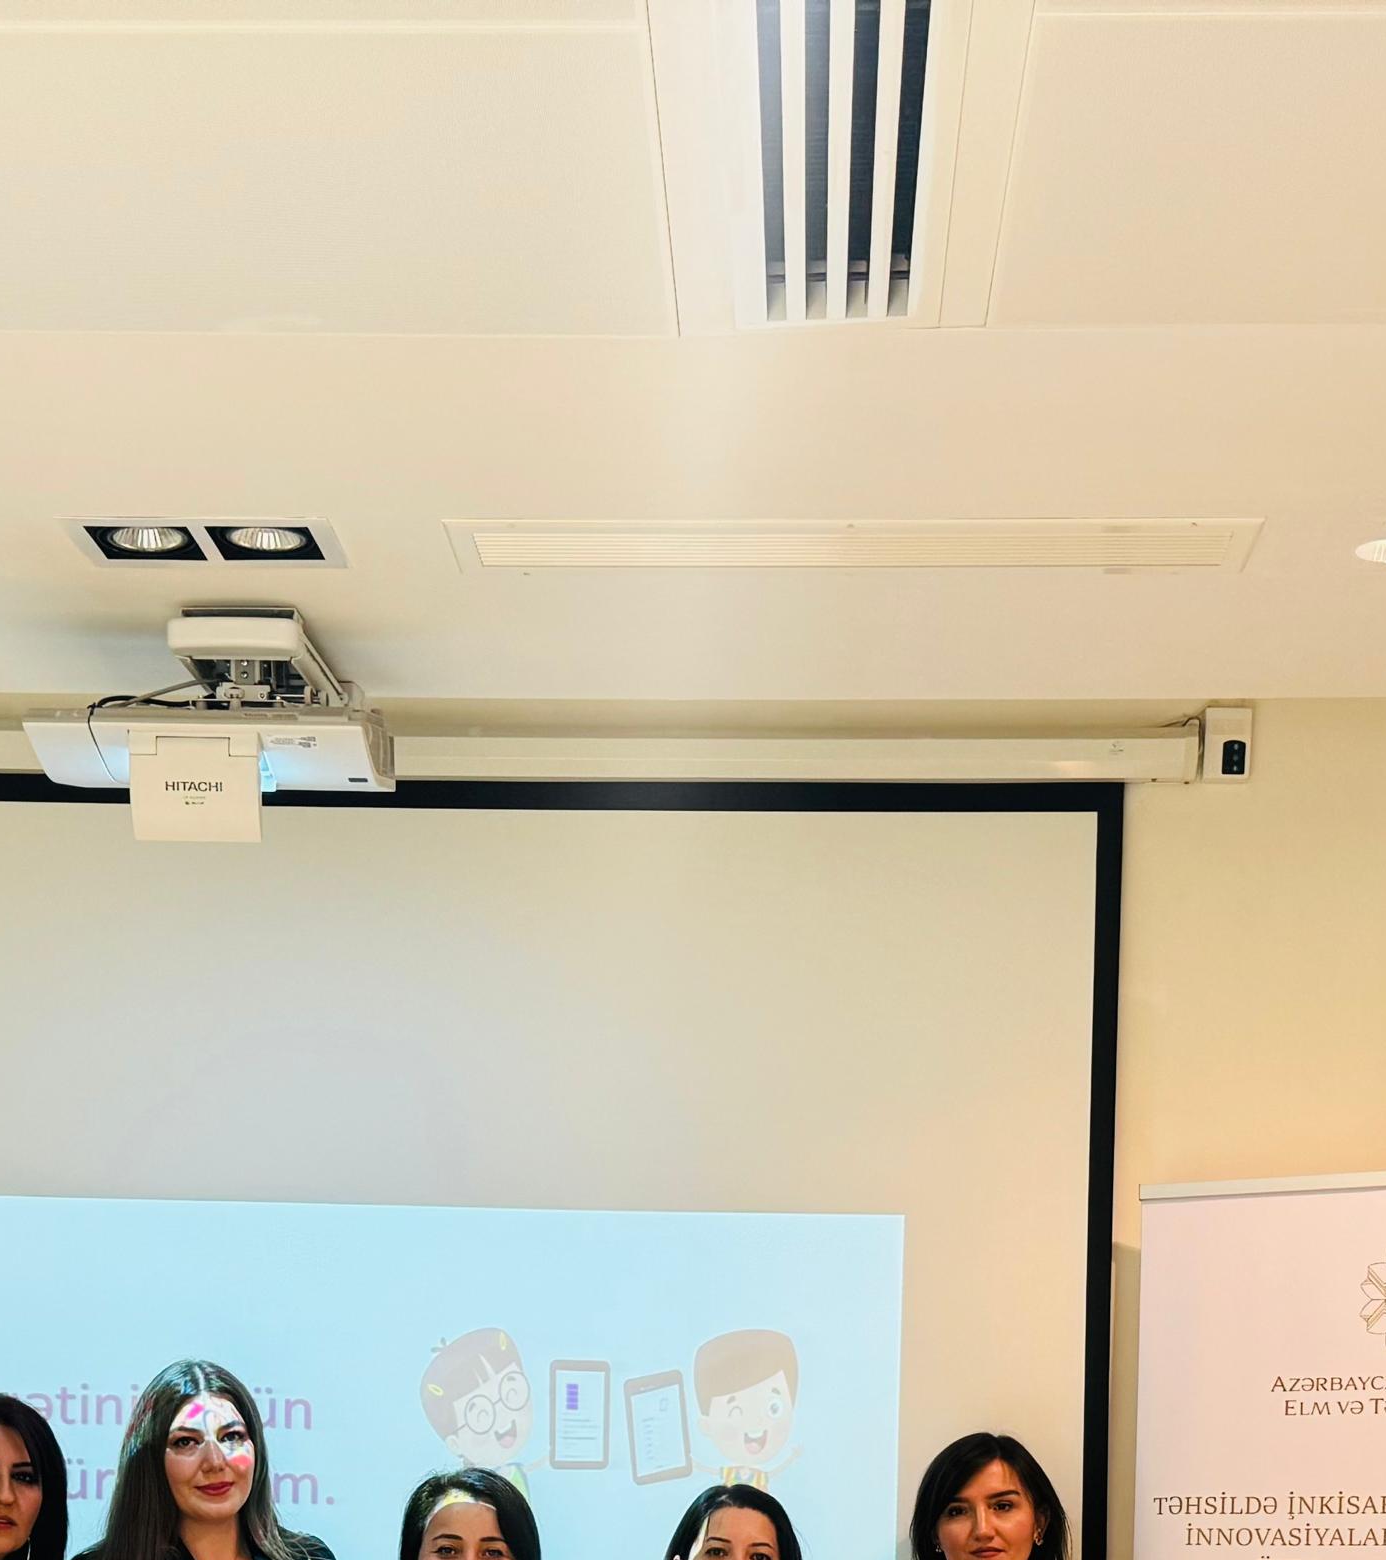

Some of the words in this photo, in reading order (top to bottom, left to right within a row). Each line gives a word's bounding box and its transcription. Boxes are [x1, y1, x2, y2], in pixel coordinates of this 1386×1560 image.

[165, 781, 223, 792] HITACHI
[1284, 1399, 1331, 1416] ELM
[1153, 1491, 1278, 1515] TƏHSİLDƏ
